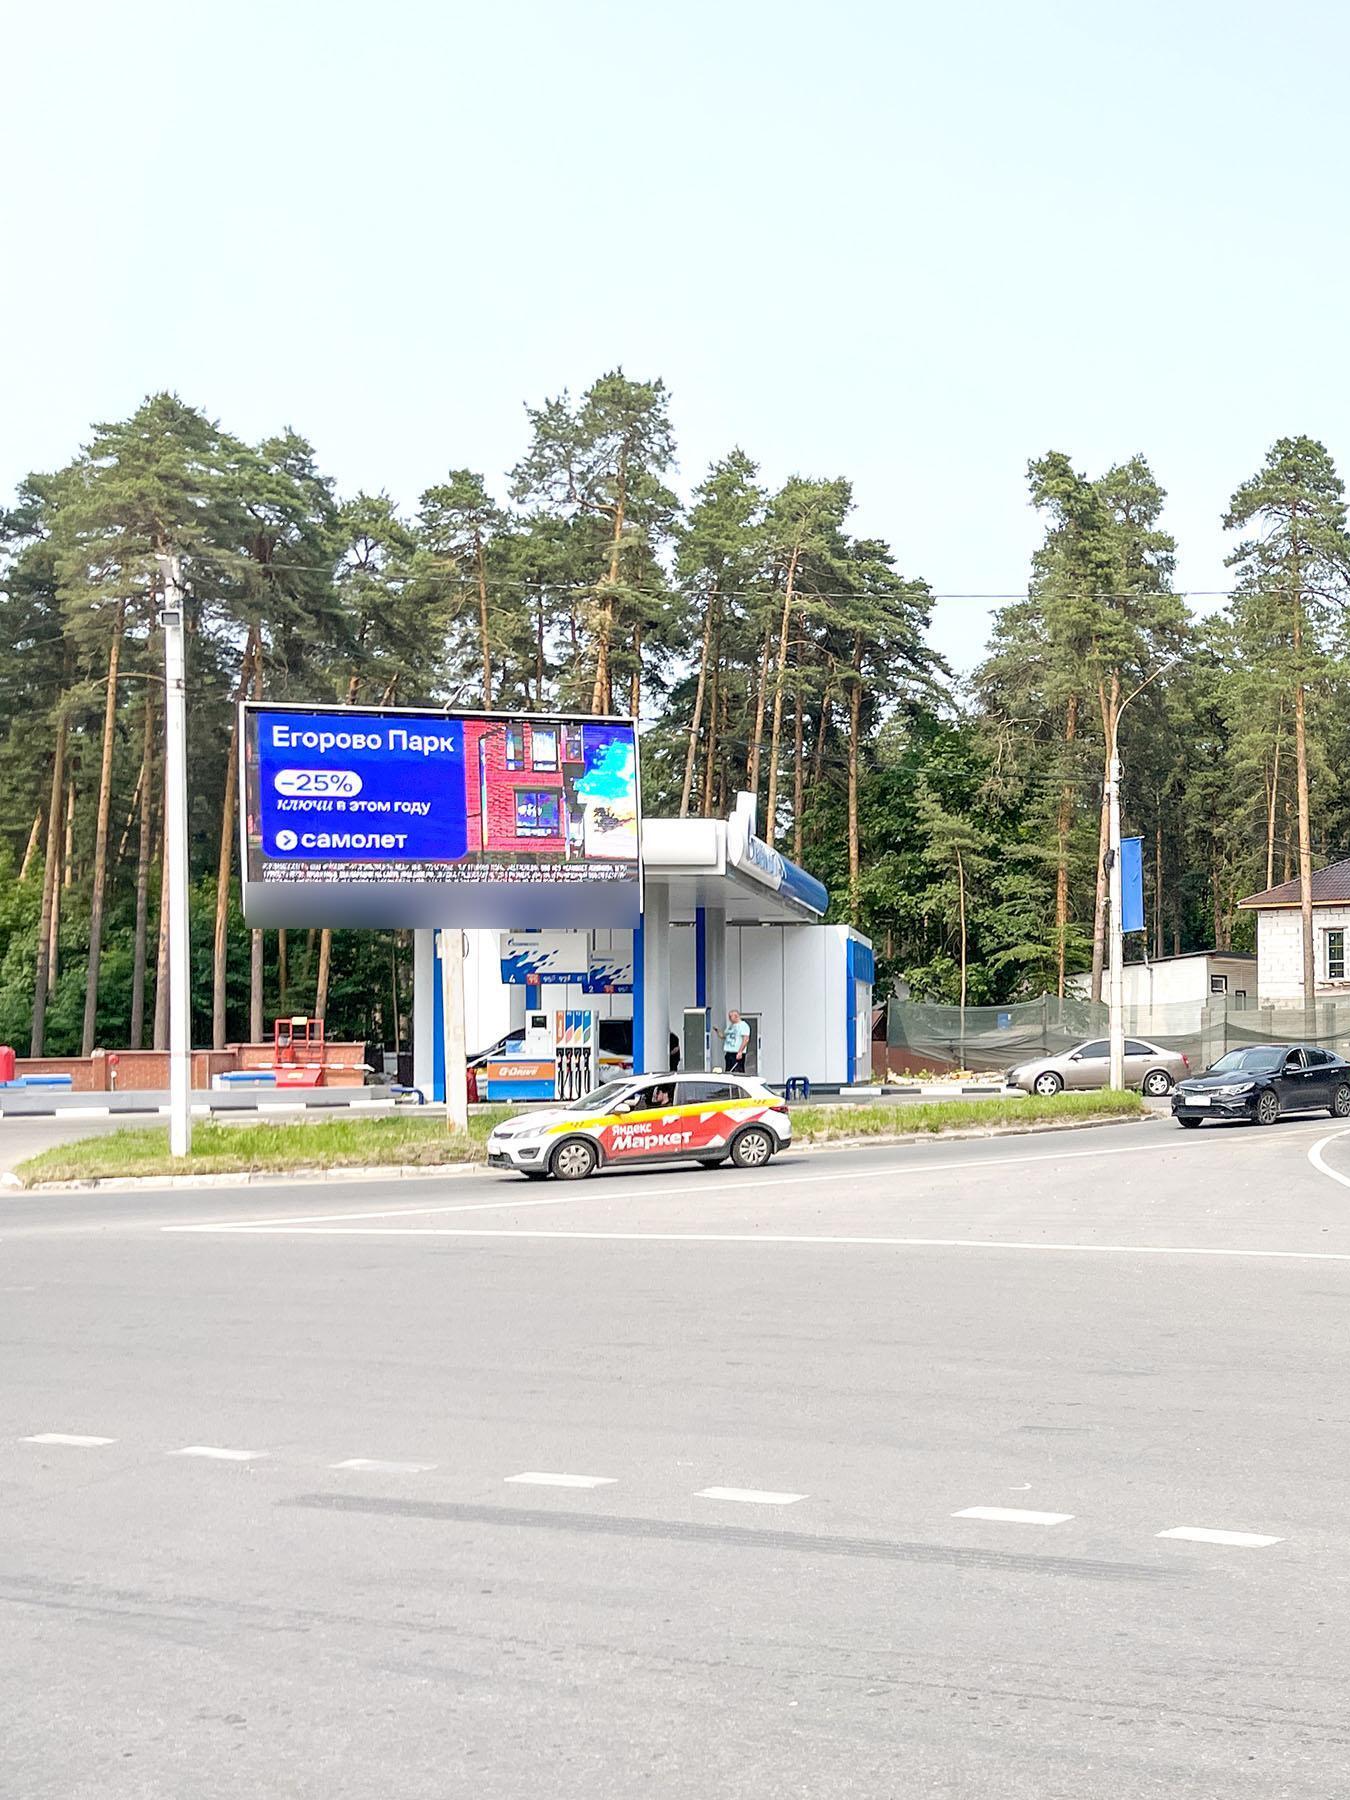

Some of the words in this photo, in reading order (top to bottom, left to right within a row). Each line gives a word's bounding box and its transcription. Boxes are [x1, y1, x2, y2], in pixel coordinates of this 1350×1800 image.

[272, 725, 383, 753] Егорово
[388, 729, 455, 756] Парк
[281, 774, 353, 792] -25%
[277, 800, 334, 811] ключи
[336, 801, 346, 811] в
[350, 801, 390, 812] этом
[394, 801, 431, 816] году
[301, 833, 408, 849] самолет
[508, 974, 516, 983] 4
[611, 1123, 652, 1136] Яндекс
[612, 1131, 693, 1151] Маркет
